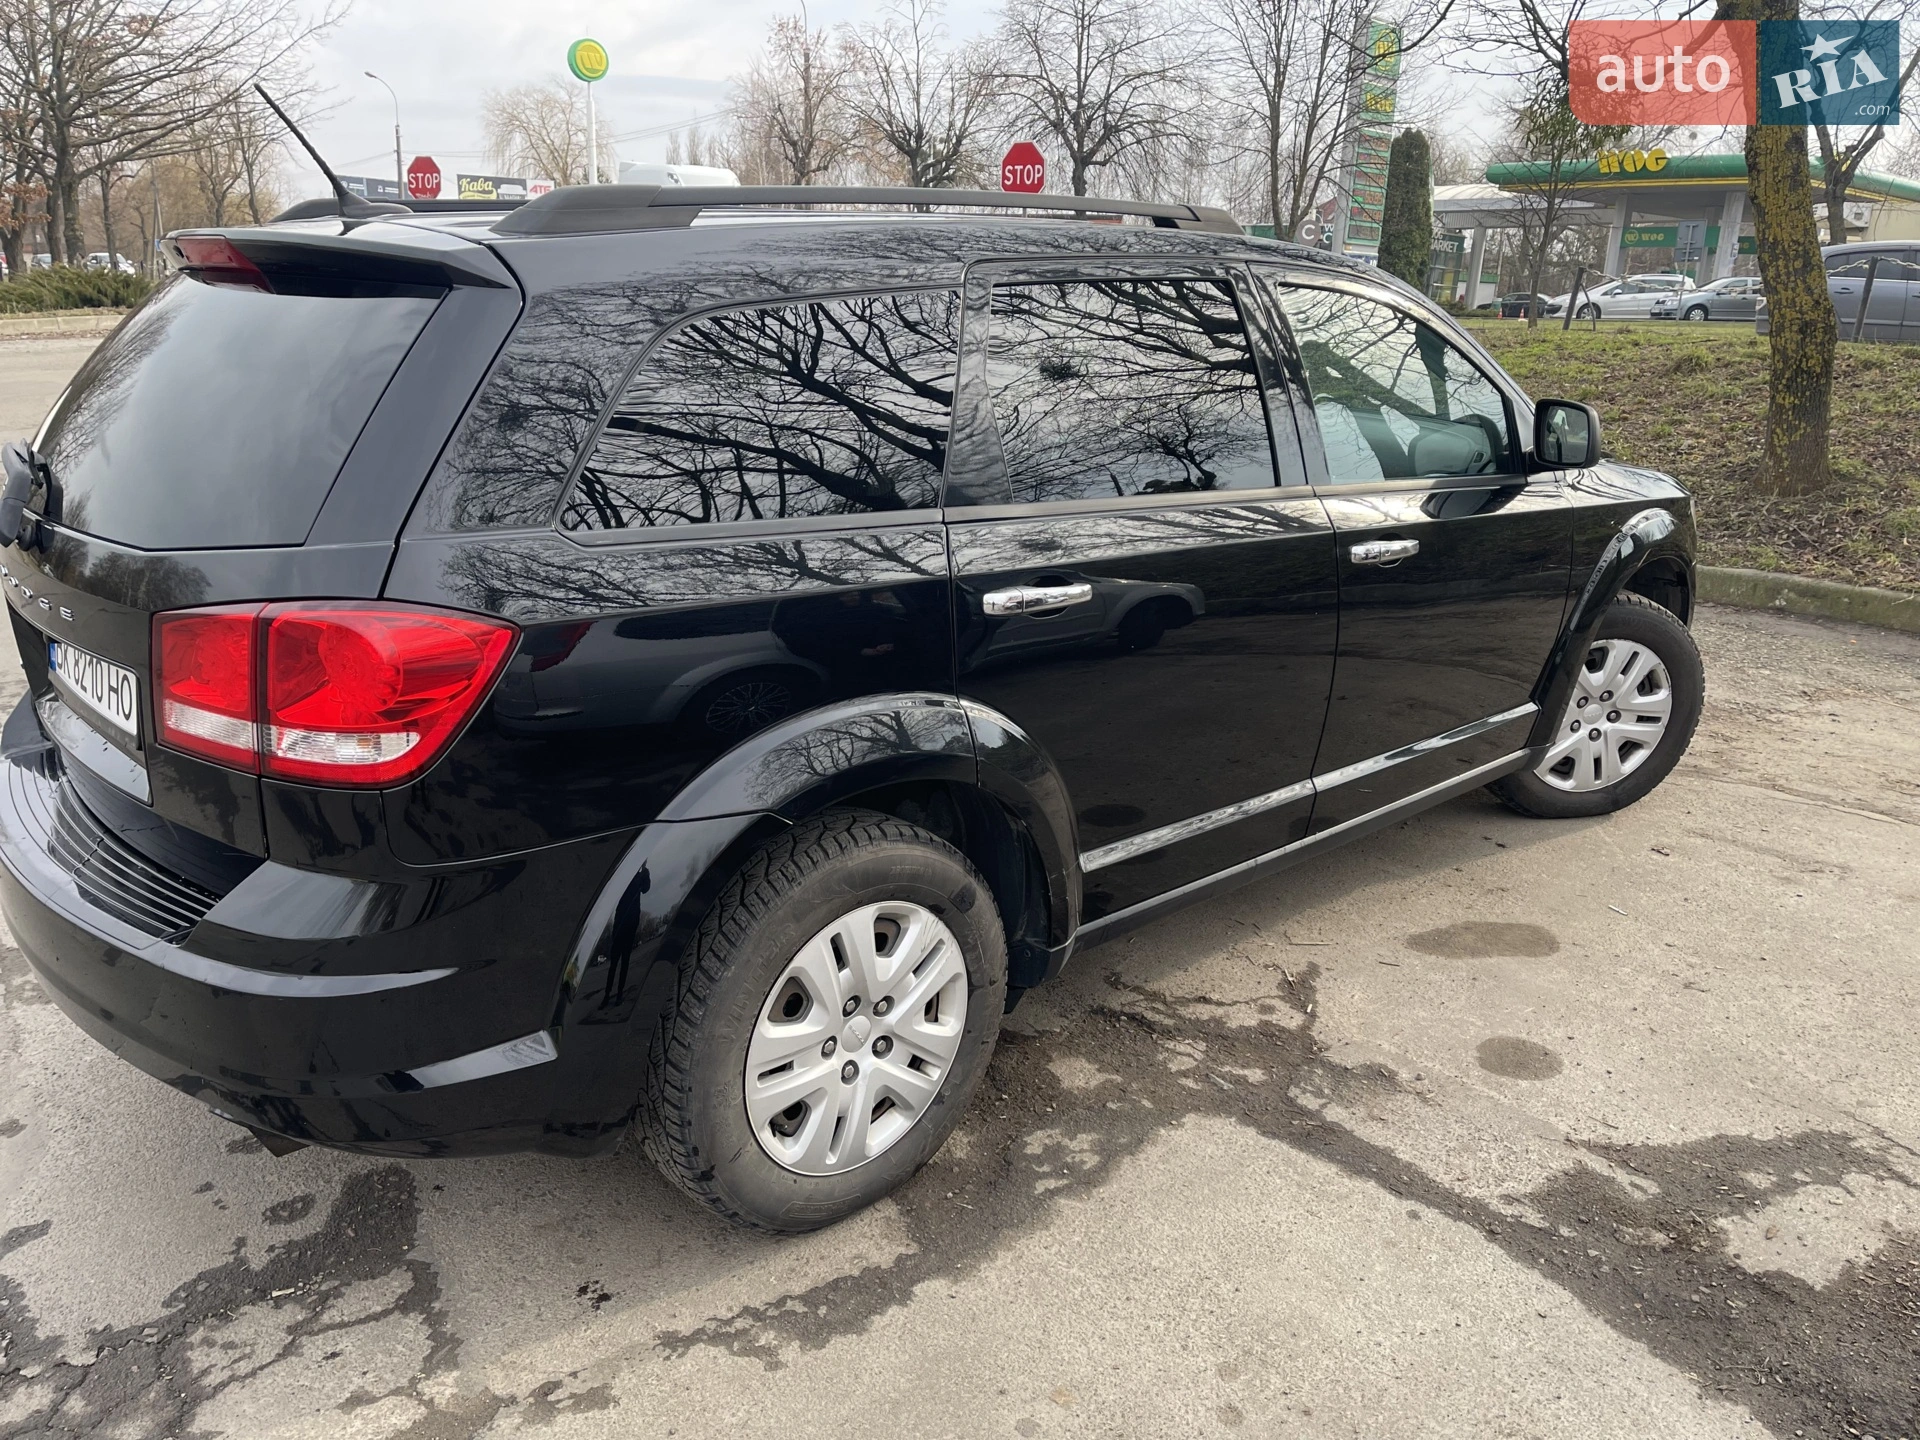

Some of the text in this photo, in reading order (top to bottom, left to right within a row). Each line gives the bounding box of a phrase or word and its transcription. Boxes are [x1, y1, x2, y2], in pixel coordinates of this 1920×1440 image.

[1597, 147, 1669, 173] WOG
[408, 173, 440, 189] STOP
[1004, 164, 1043, 185] STOP
[459, 178, 493, 192] Кава
[1641, 233, 1665, 241] WOG
[74, 648, 104, 703] 8210
[108, 664, 132, 721] HO
